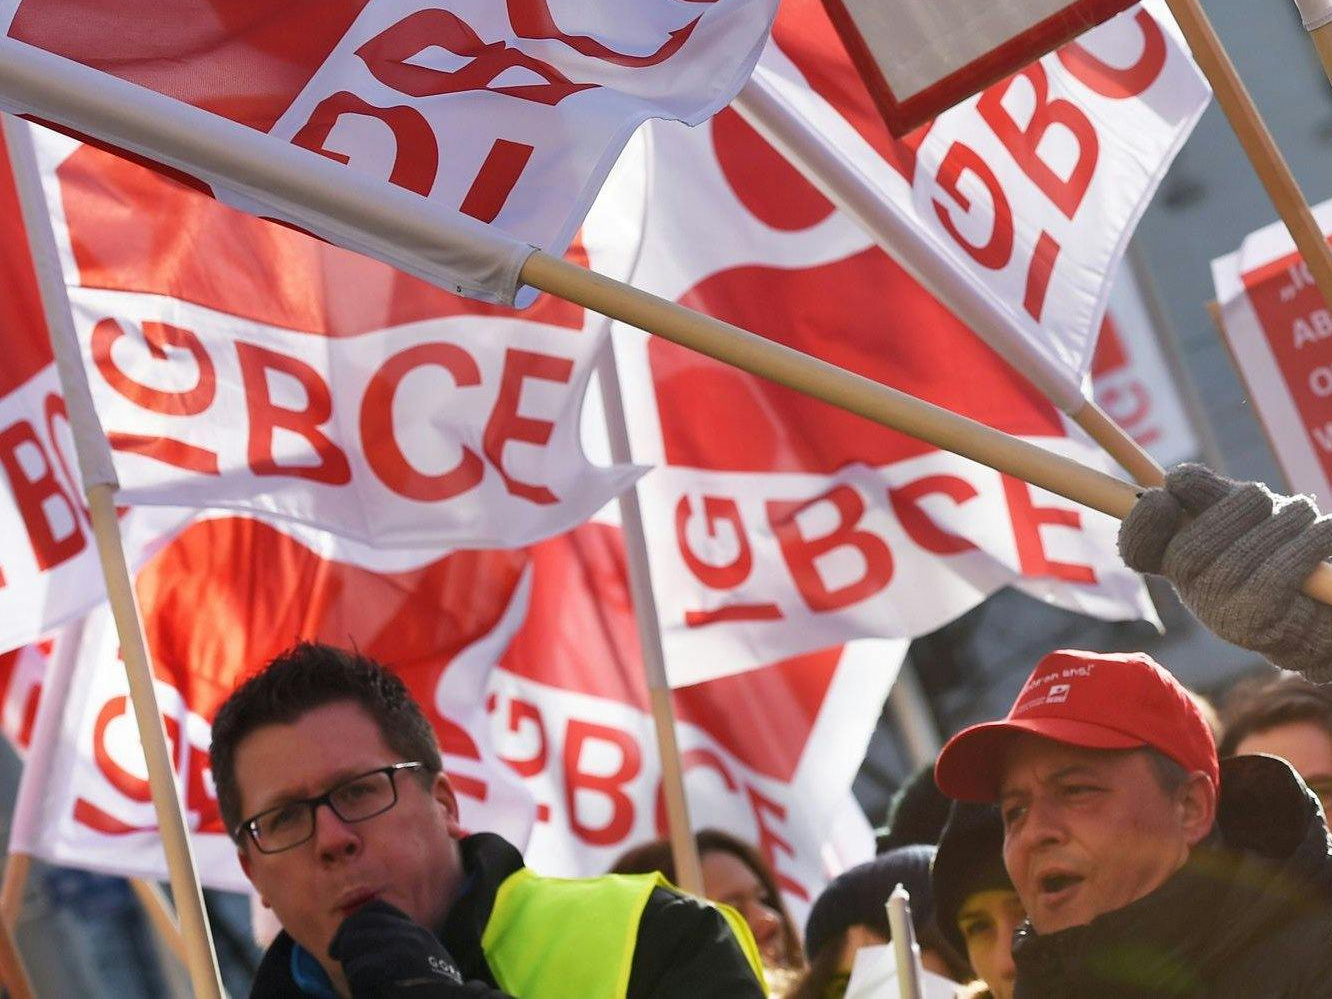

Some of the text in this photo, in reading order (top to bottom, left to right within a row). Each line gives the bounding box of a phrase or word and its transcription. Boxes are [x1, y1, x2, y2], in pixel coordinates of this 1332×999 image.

[932, 4, 1167, 324] IG BC
[91, 317, 574, 506] IG BCE
[675, 472, 1098, 628] IG BCE
